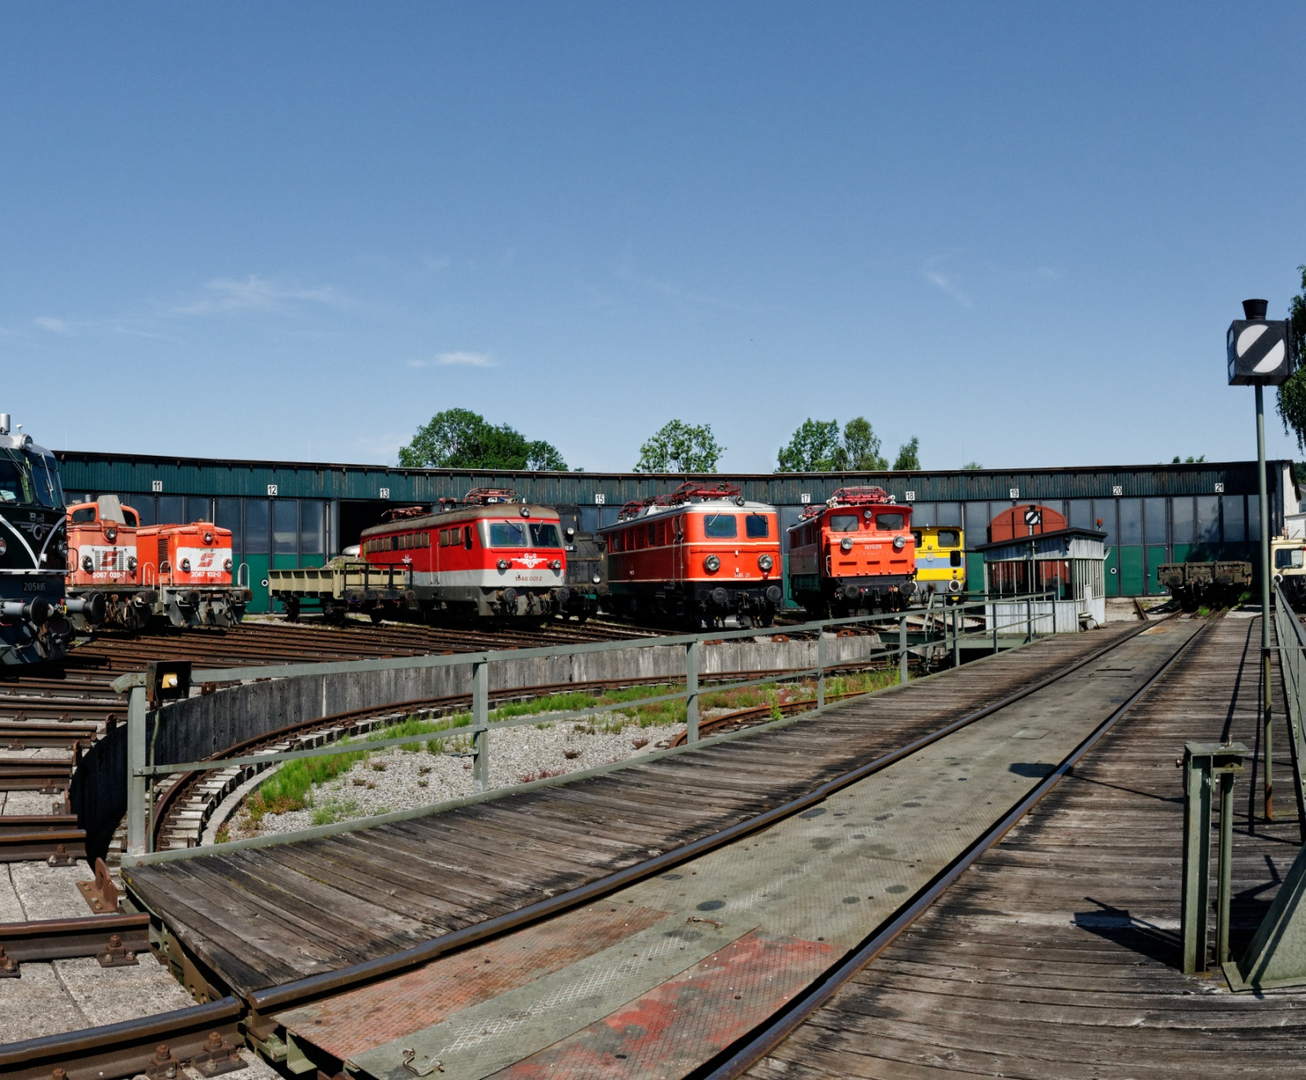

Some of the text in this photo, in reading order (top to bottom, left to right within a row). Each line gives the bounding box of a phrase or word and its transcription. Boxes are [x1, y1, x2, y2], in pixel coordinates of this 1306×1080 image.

[153, 482, 161, 491] 11
[268, 485, 277, 495] 12
[1113, 486, 1122, 495] 20
[1215, 483, 1223, 492] 21
[381, 488, 389, 498] 13
[906, 491, 914, 500] 18
[1010, 489, 1018, 498] 19
[596, 494, 604, 504] 15
[802, 494, 810, 503] 17
